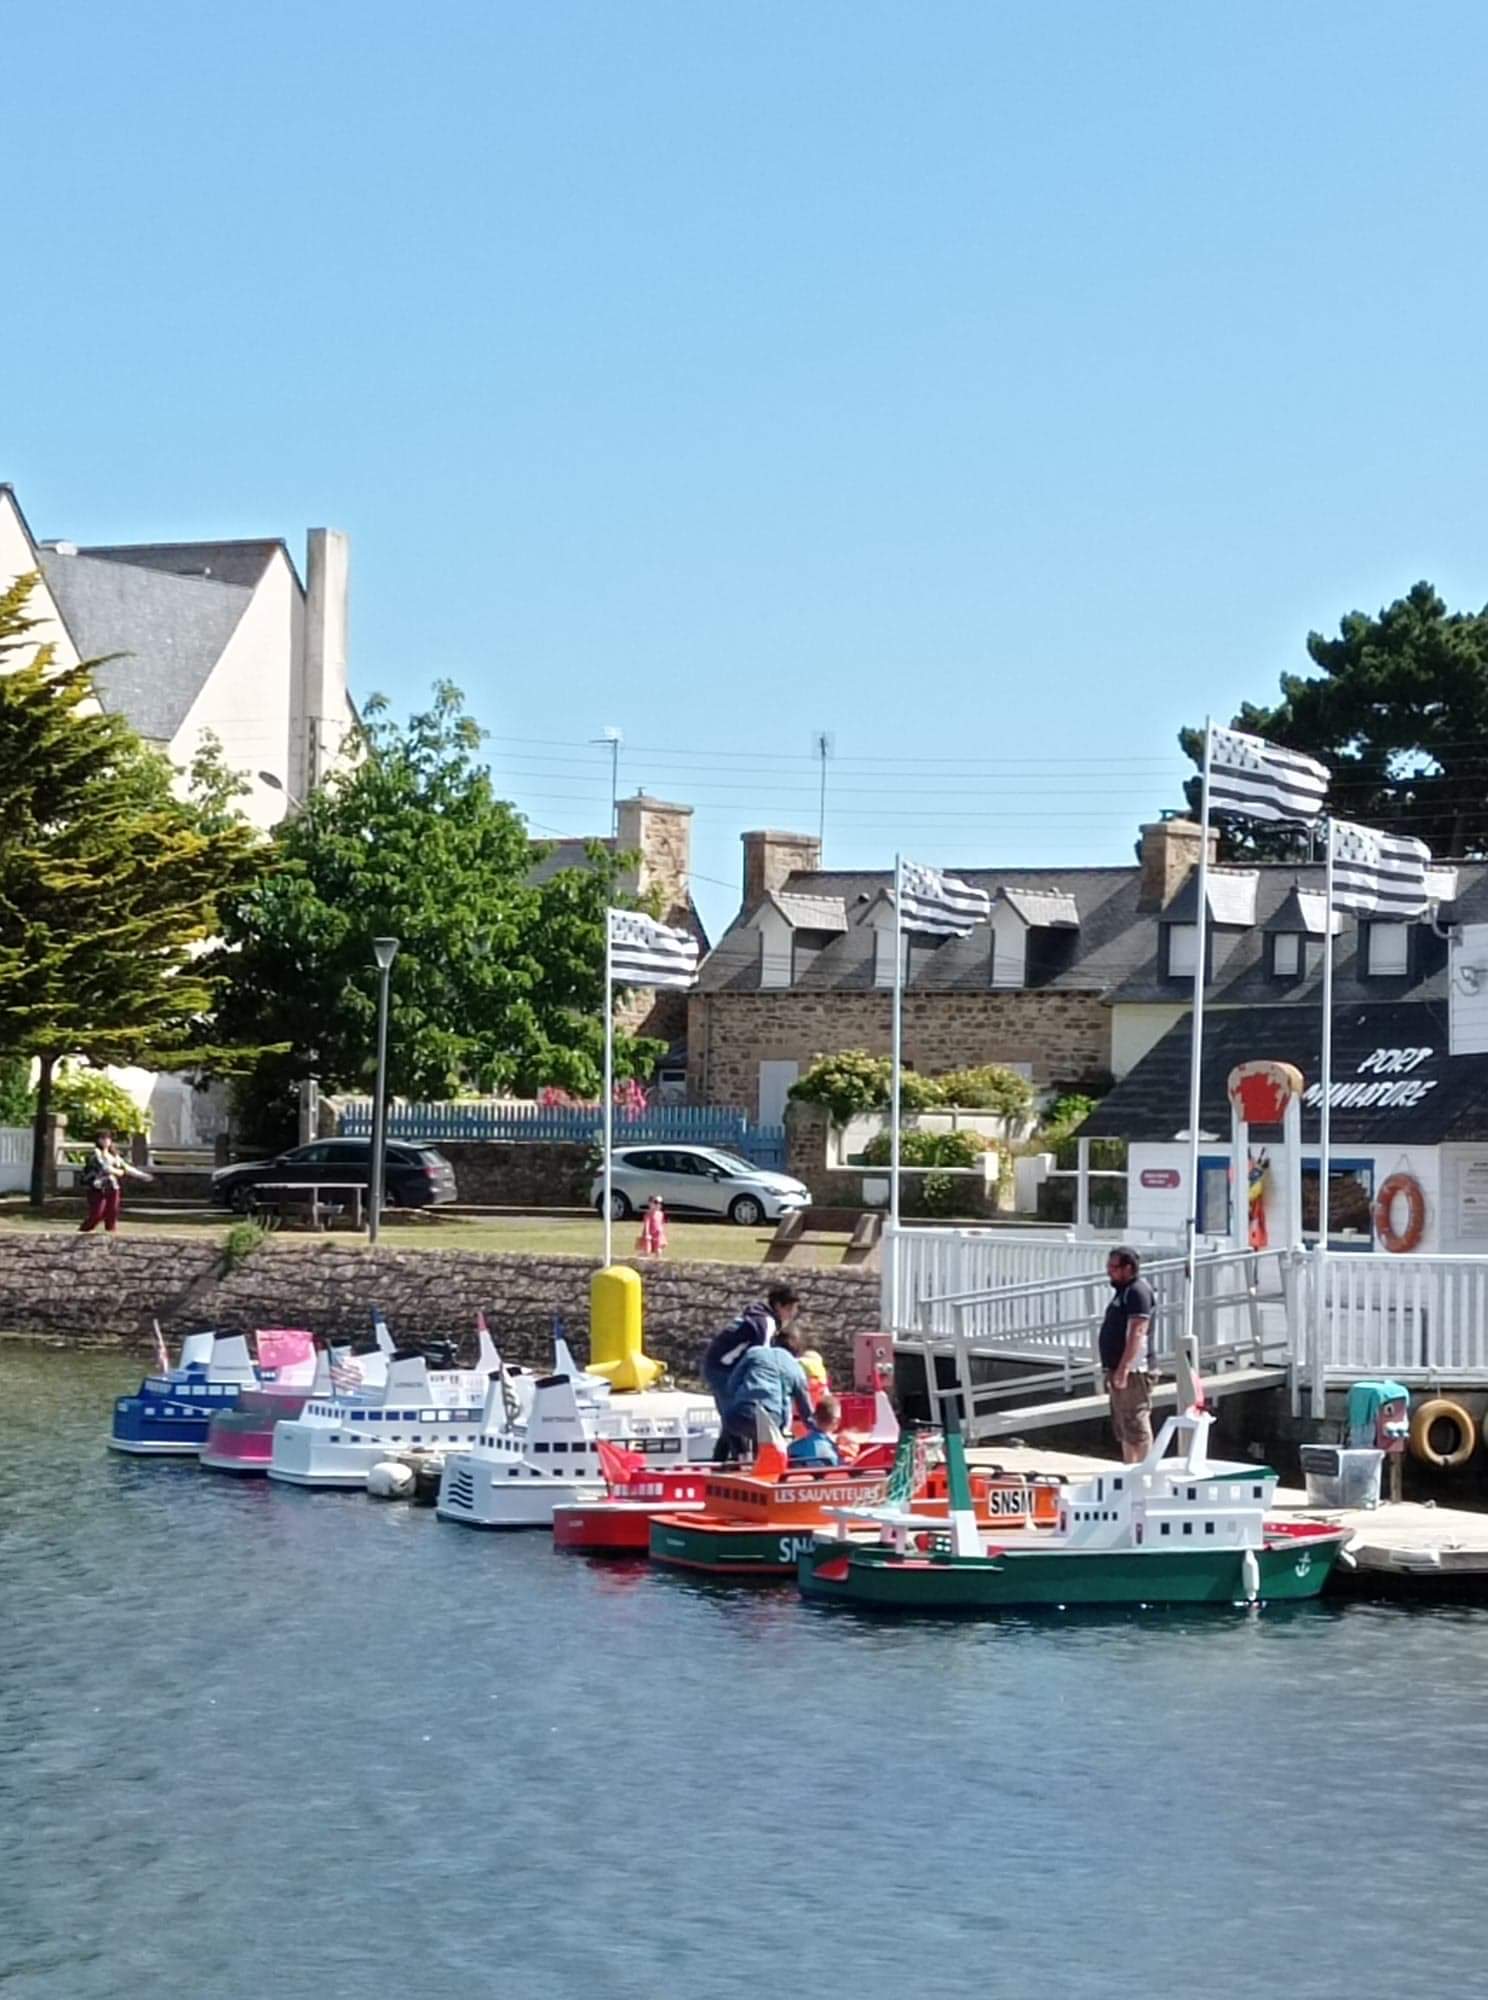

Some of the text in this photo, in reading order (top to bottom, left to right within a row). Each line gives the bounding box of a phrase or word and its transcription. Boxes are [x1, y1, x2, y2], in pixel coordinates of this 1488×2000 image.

[1356, 1046, 1434, 1074] PORT
[1302, 1080, 1438, 1107] MINIATURE
[774, 1484, 880, 1503] LES SAUVETEURS
[991, 1490, 1034, 1514] SNSM
